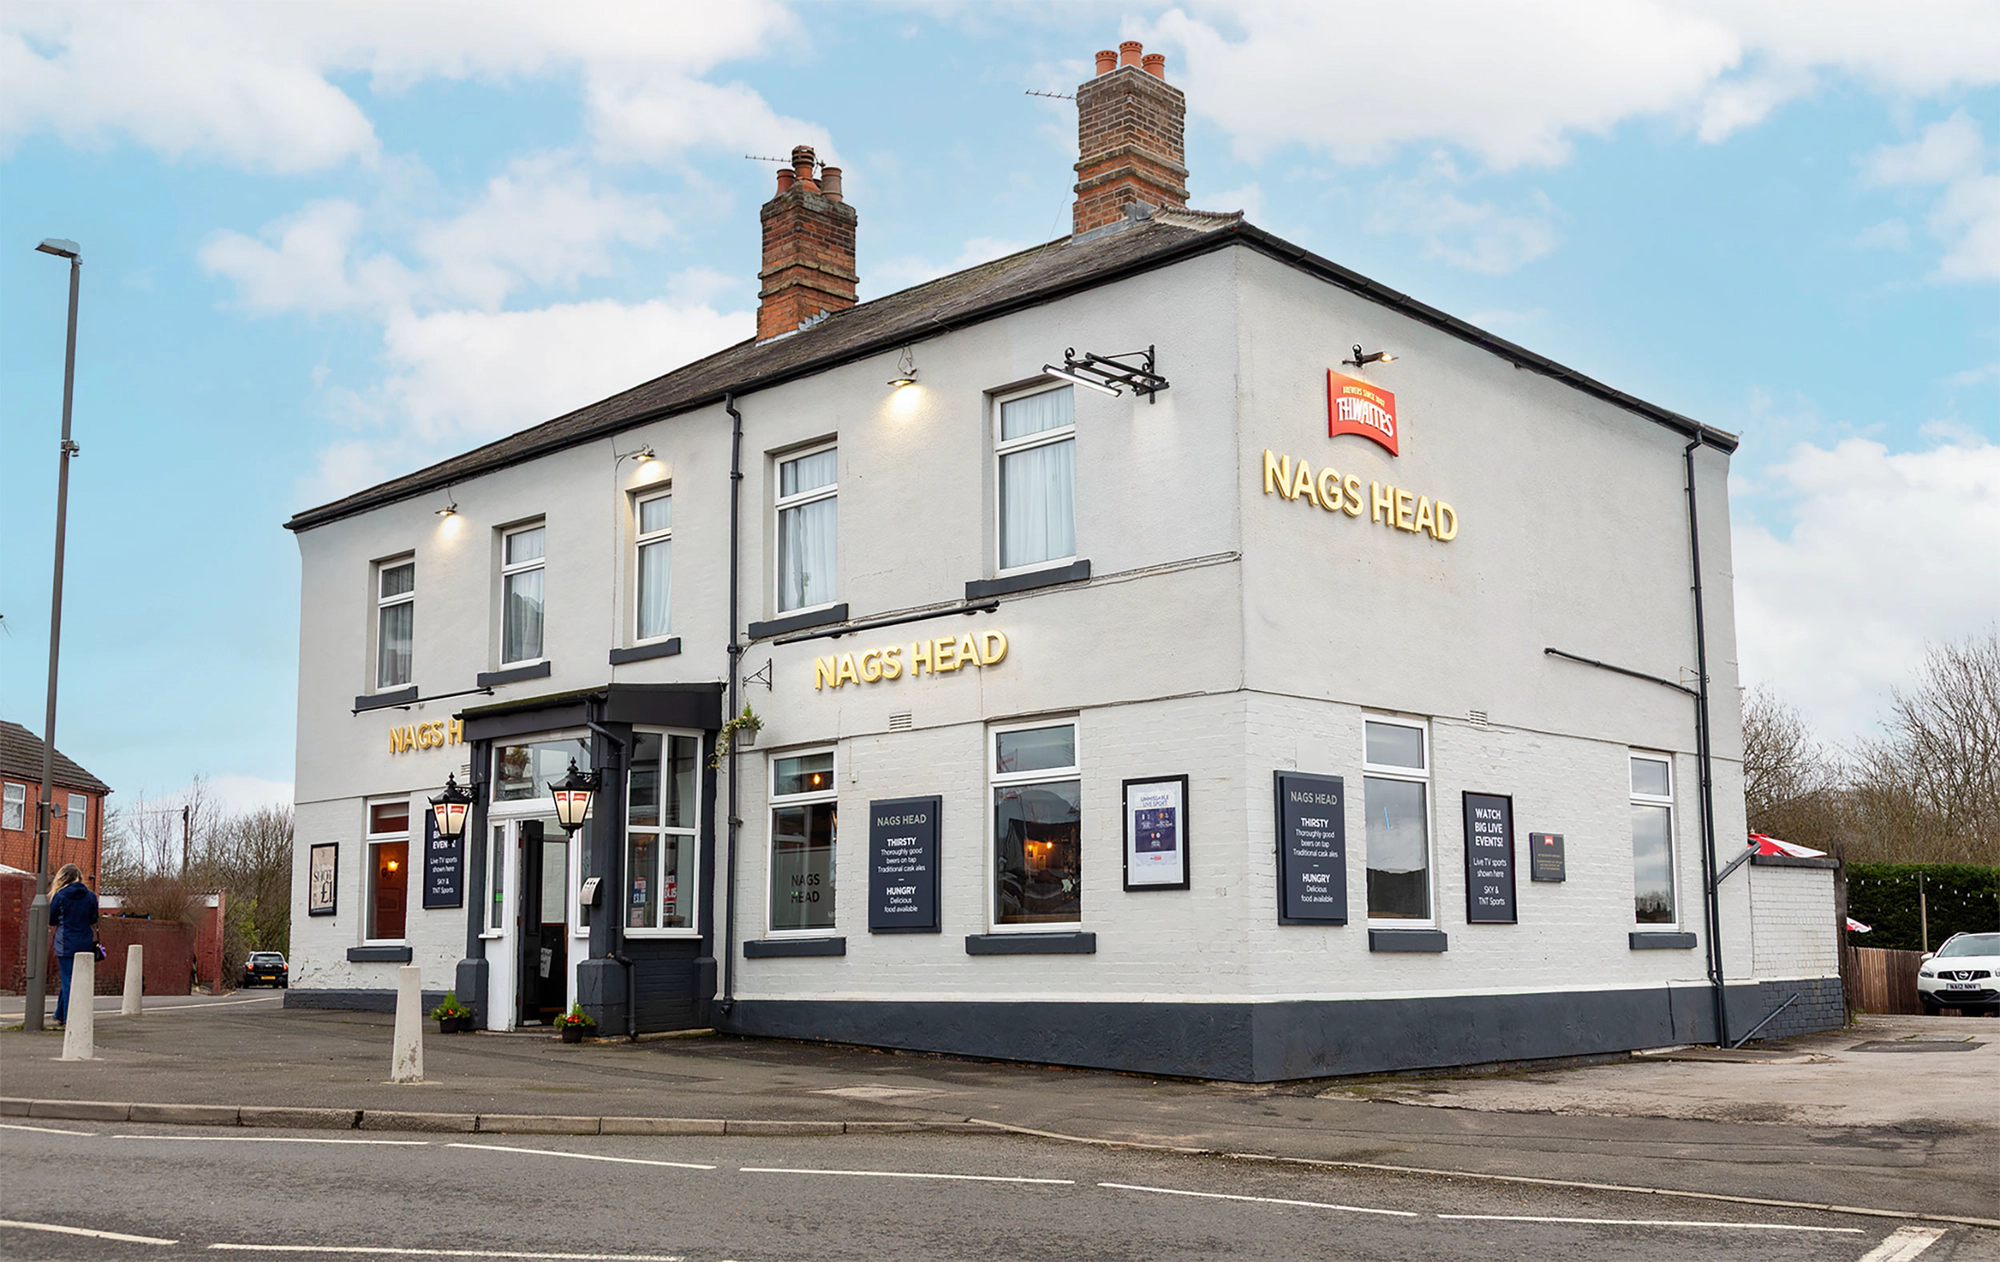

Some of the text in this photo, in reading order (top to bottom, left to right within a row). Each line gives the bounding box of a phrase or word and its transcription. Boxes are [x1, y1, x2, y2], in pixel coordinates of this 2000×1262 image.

[1342, 386, 1362, 395] BREWERS
[1363, 389, 1375, 401] SINCE
[1336, 397, 1394, 437] THWAITES
[1264, 449, 1458, 542] NAGS HEAD
[815, 629, 1008, 690] NAGS HEAD
[389, 720, 444, 754] NAGS
[1291, 791, 1338, 805] NAGS HEAD
[1475, 808, 1501, 820] WATCH
[877, 814, 927, 827] NAGS HEAD
[1301, 818, 1329, 828] THIRSTY
[1475, 822, 1503, 834] BIG LIVE
[1296, 829, 1335, 839] Thoroughly good
[887, 837, 917, 847] THIRSTY
[1301, 839, 1314, 847] beers
[1476, 836, 1504, 847] EVENTS!
[909, 847, 923, 856] good
[1293, 848, 1317, 857] Traditional
[1318, 850, 1328, 858] cask
[445, 857, 458, 865] sports
[1473, 858, 1507, 867] Live TV sports
[878, 865, 903, 873] Traditional
[1477, 869, 1504, 878] shown here
[437, 878, 445, 886] SKY
[792, 874, 820, 886] NAGS
[1302, 874, 1330, 883] HUNGRY
[321, 881, 333, 904] £1
[441, 886, 454, 894] Sports
[887, 886, 917, 895] HUNGRY
[1306, 885, 1328, 893] Delicious
[1484, 886, 1500, 895] SKY &
[791, 891, 820, 903] HEAD
[1313, 895, 1334, 903] available
[1479, 897, 1506, 907] TNT Sports
